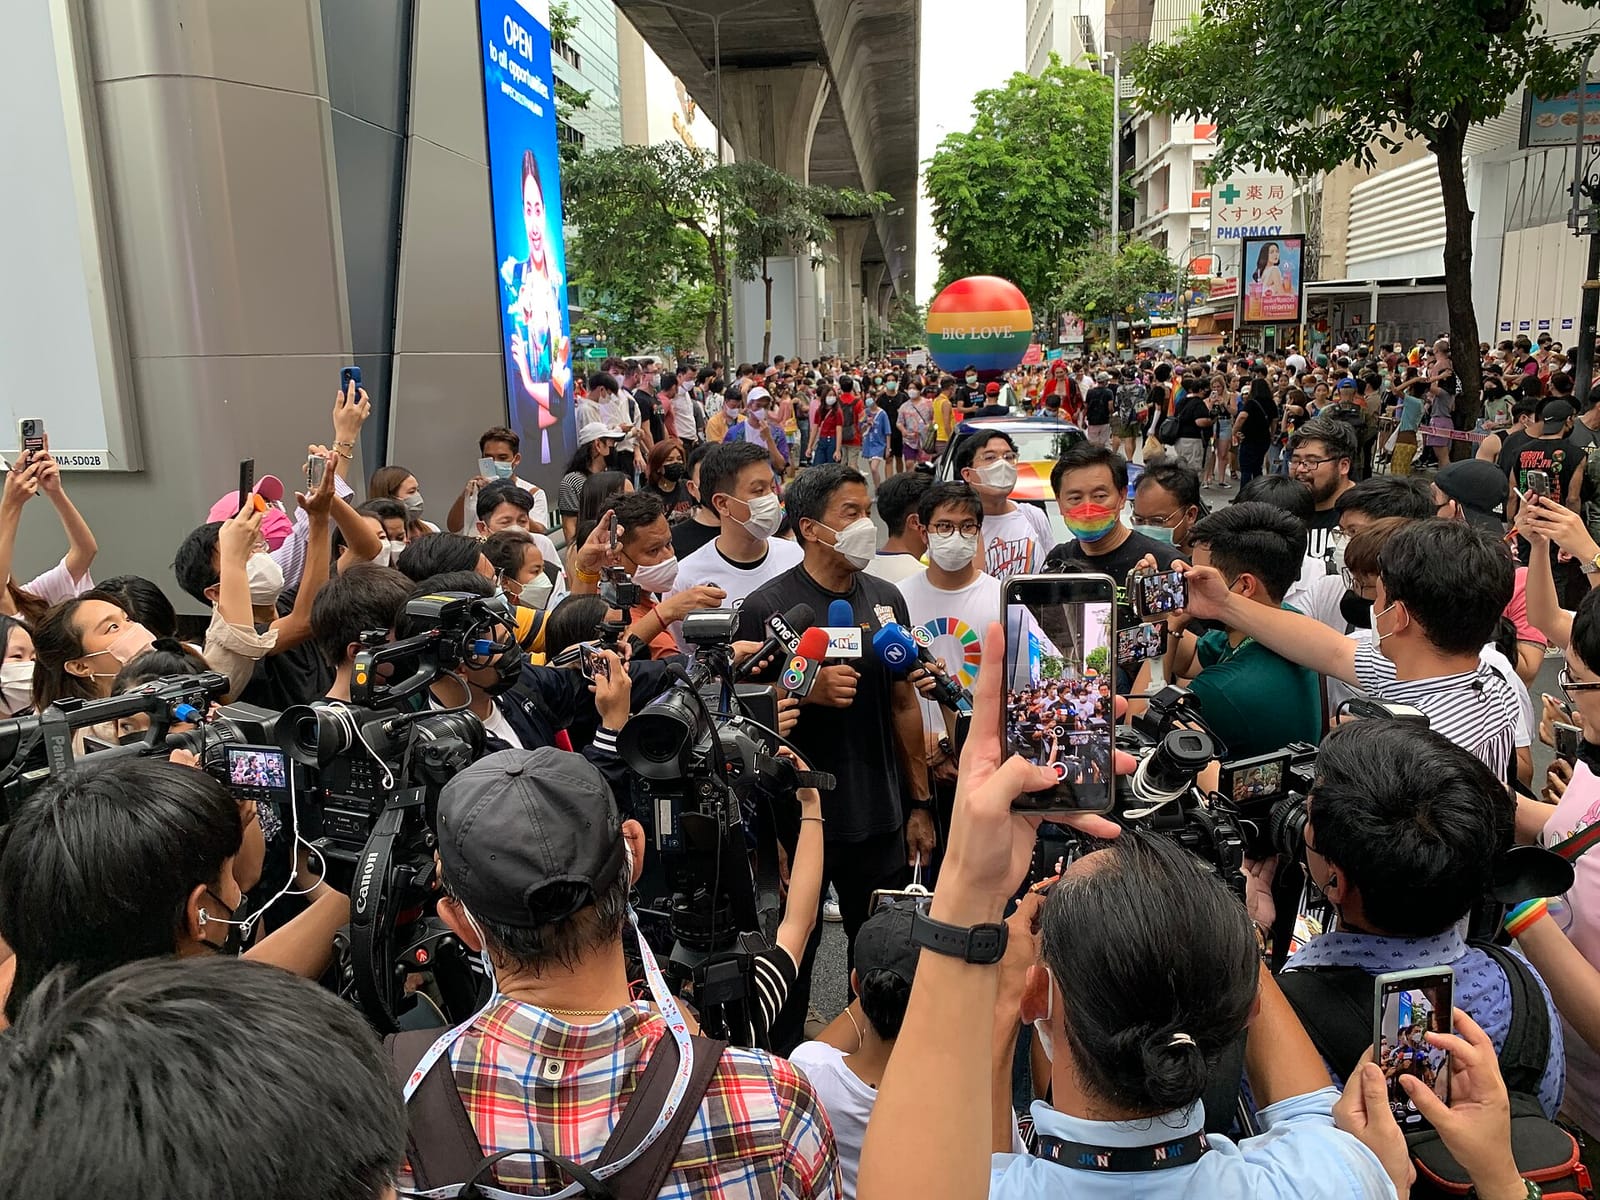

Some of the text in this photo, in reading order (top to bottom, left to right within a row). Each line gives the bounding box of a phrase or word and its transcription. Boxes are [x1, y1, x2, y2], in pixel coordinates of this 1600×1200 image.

[504, 14, 533, 63] OPEN
[489, 40, 498, 62] to
[498, 49, 508, 71] all
[1246, 184, 1284, 201] 薬局
[1217, 205, 1284, 222] くすりや
[1217, 225, 1282, 239] PHARMACY
[942, 325, 1015, 340] BIG LOVE.
[55, 455, 101, 466] MA-SD02B
[51, 735, 67, 775] Pana
[356, 852, 379, 914] Canon
[1078, 1152, 1110, 1168] JKN
